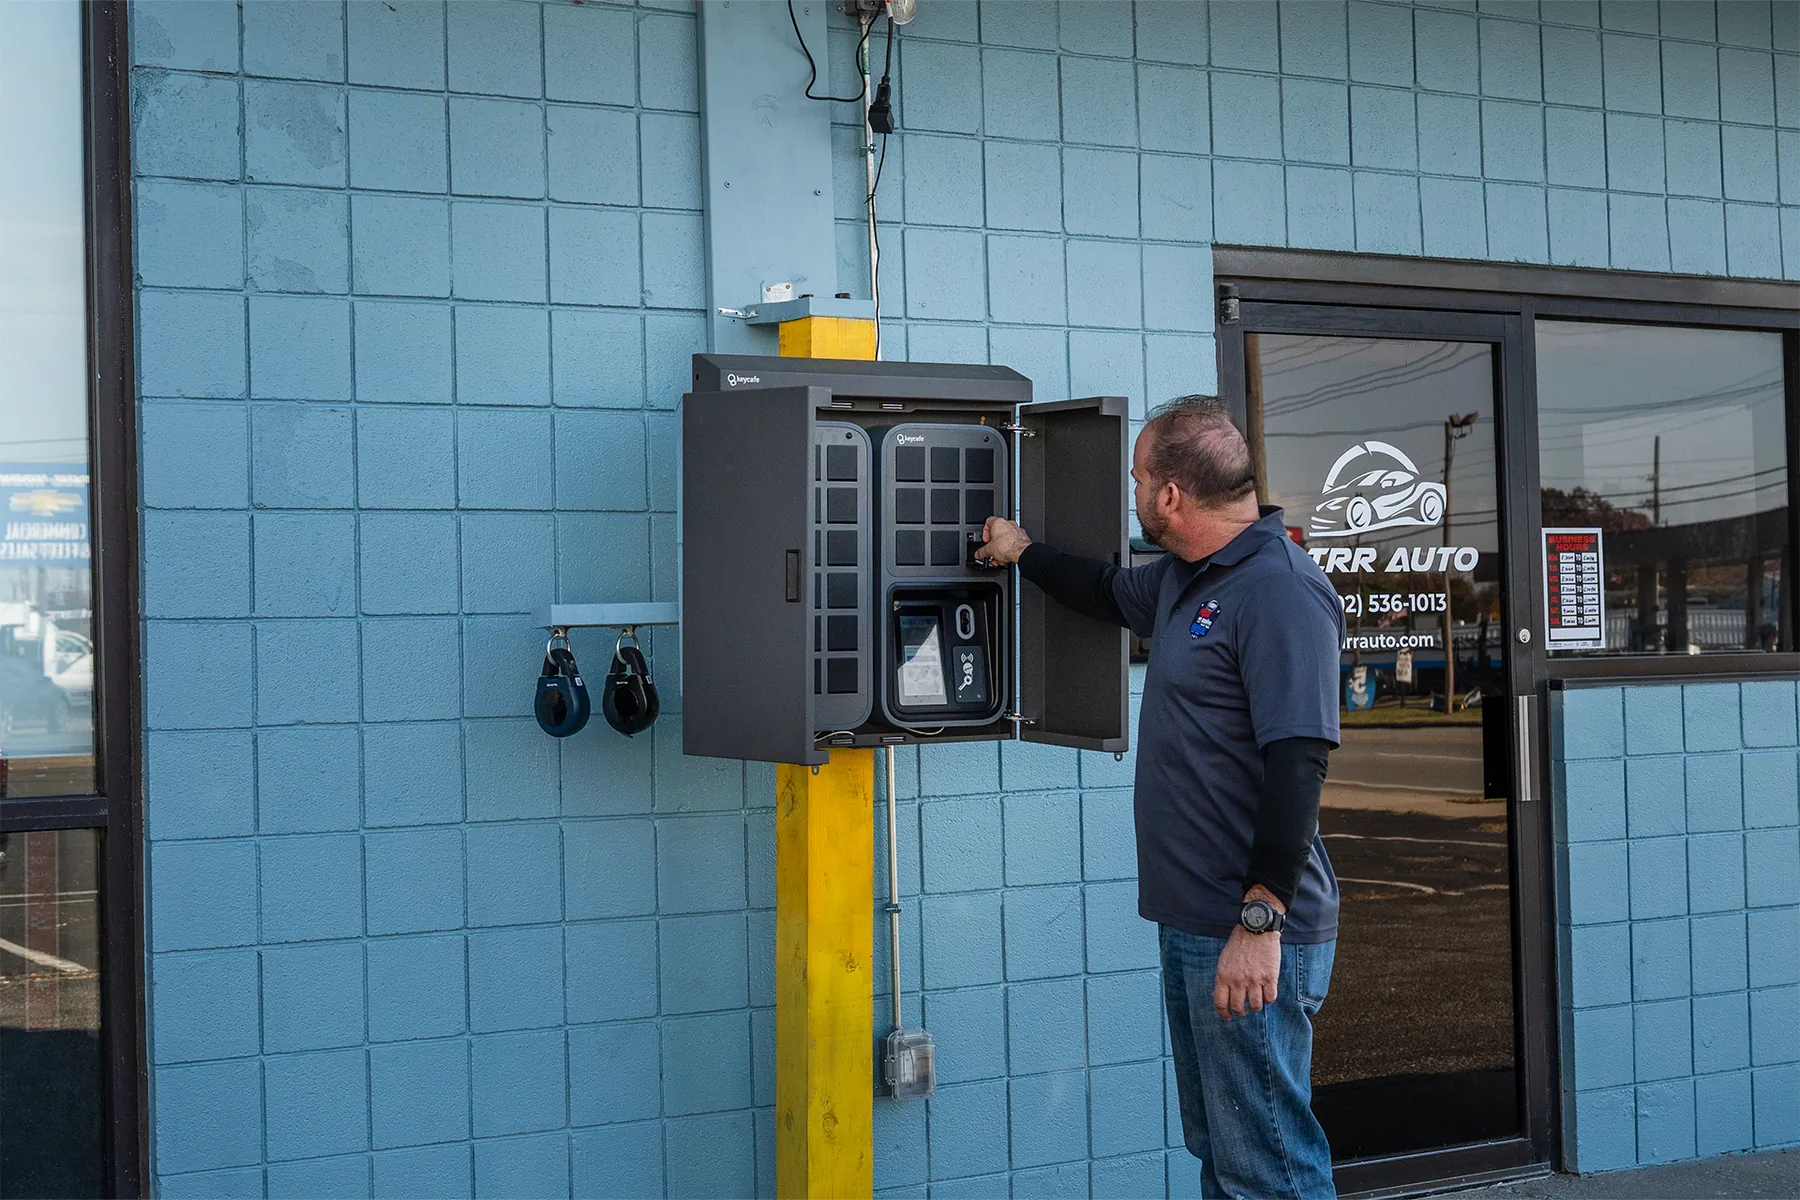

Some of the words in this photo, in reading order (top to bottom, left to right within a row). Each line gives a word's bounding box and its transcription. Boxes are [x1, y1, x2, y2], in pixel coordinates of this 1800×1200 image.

[737, 375, 760, 385] keycafe
[905, 435, 925, 443] keycafe
[1548, 535, 1596, 543] BUSINESS
[1384, 547, 1479, 572] AUTO
[1369, 594, 1447, 612] 536-1013
